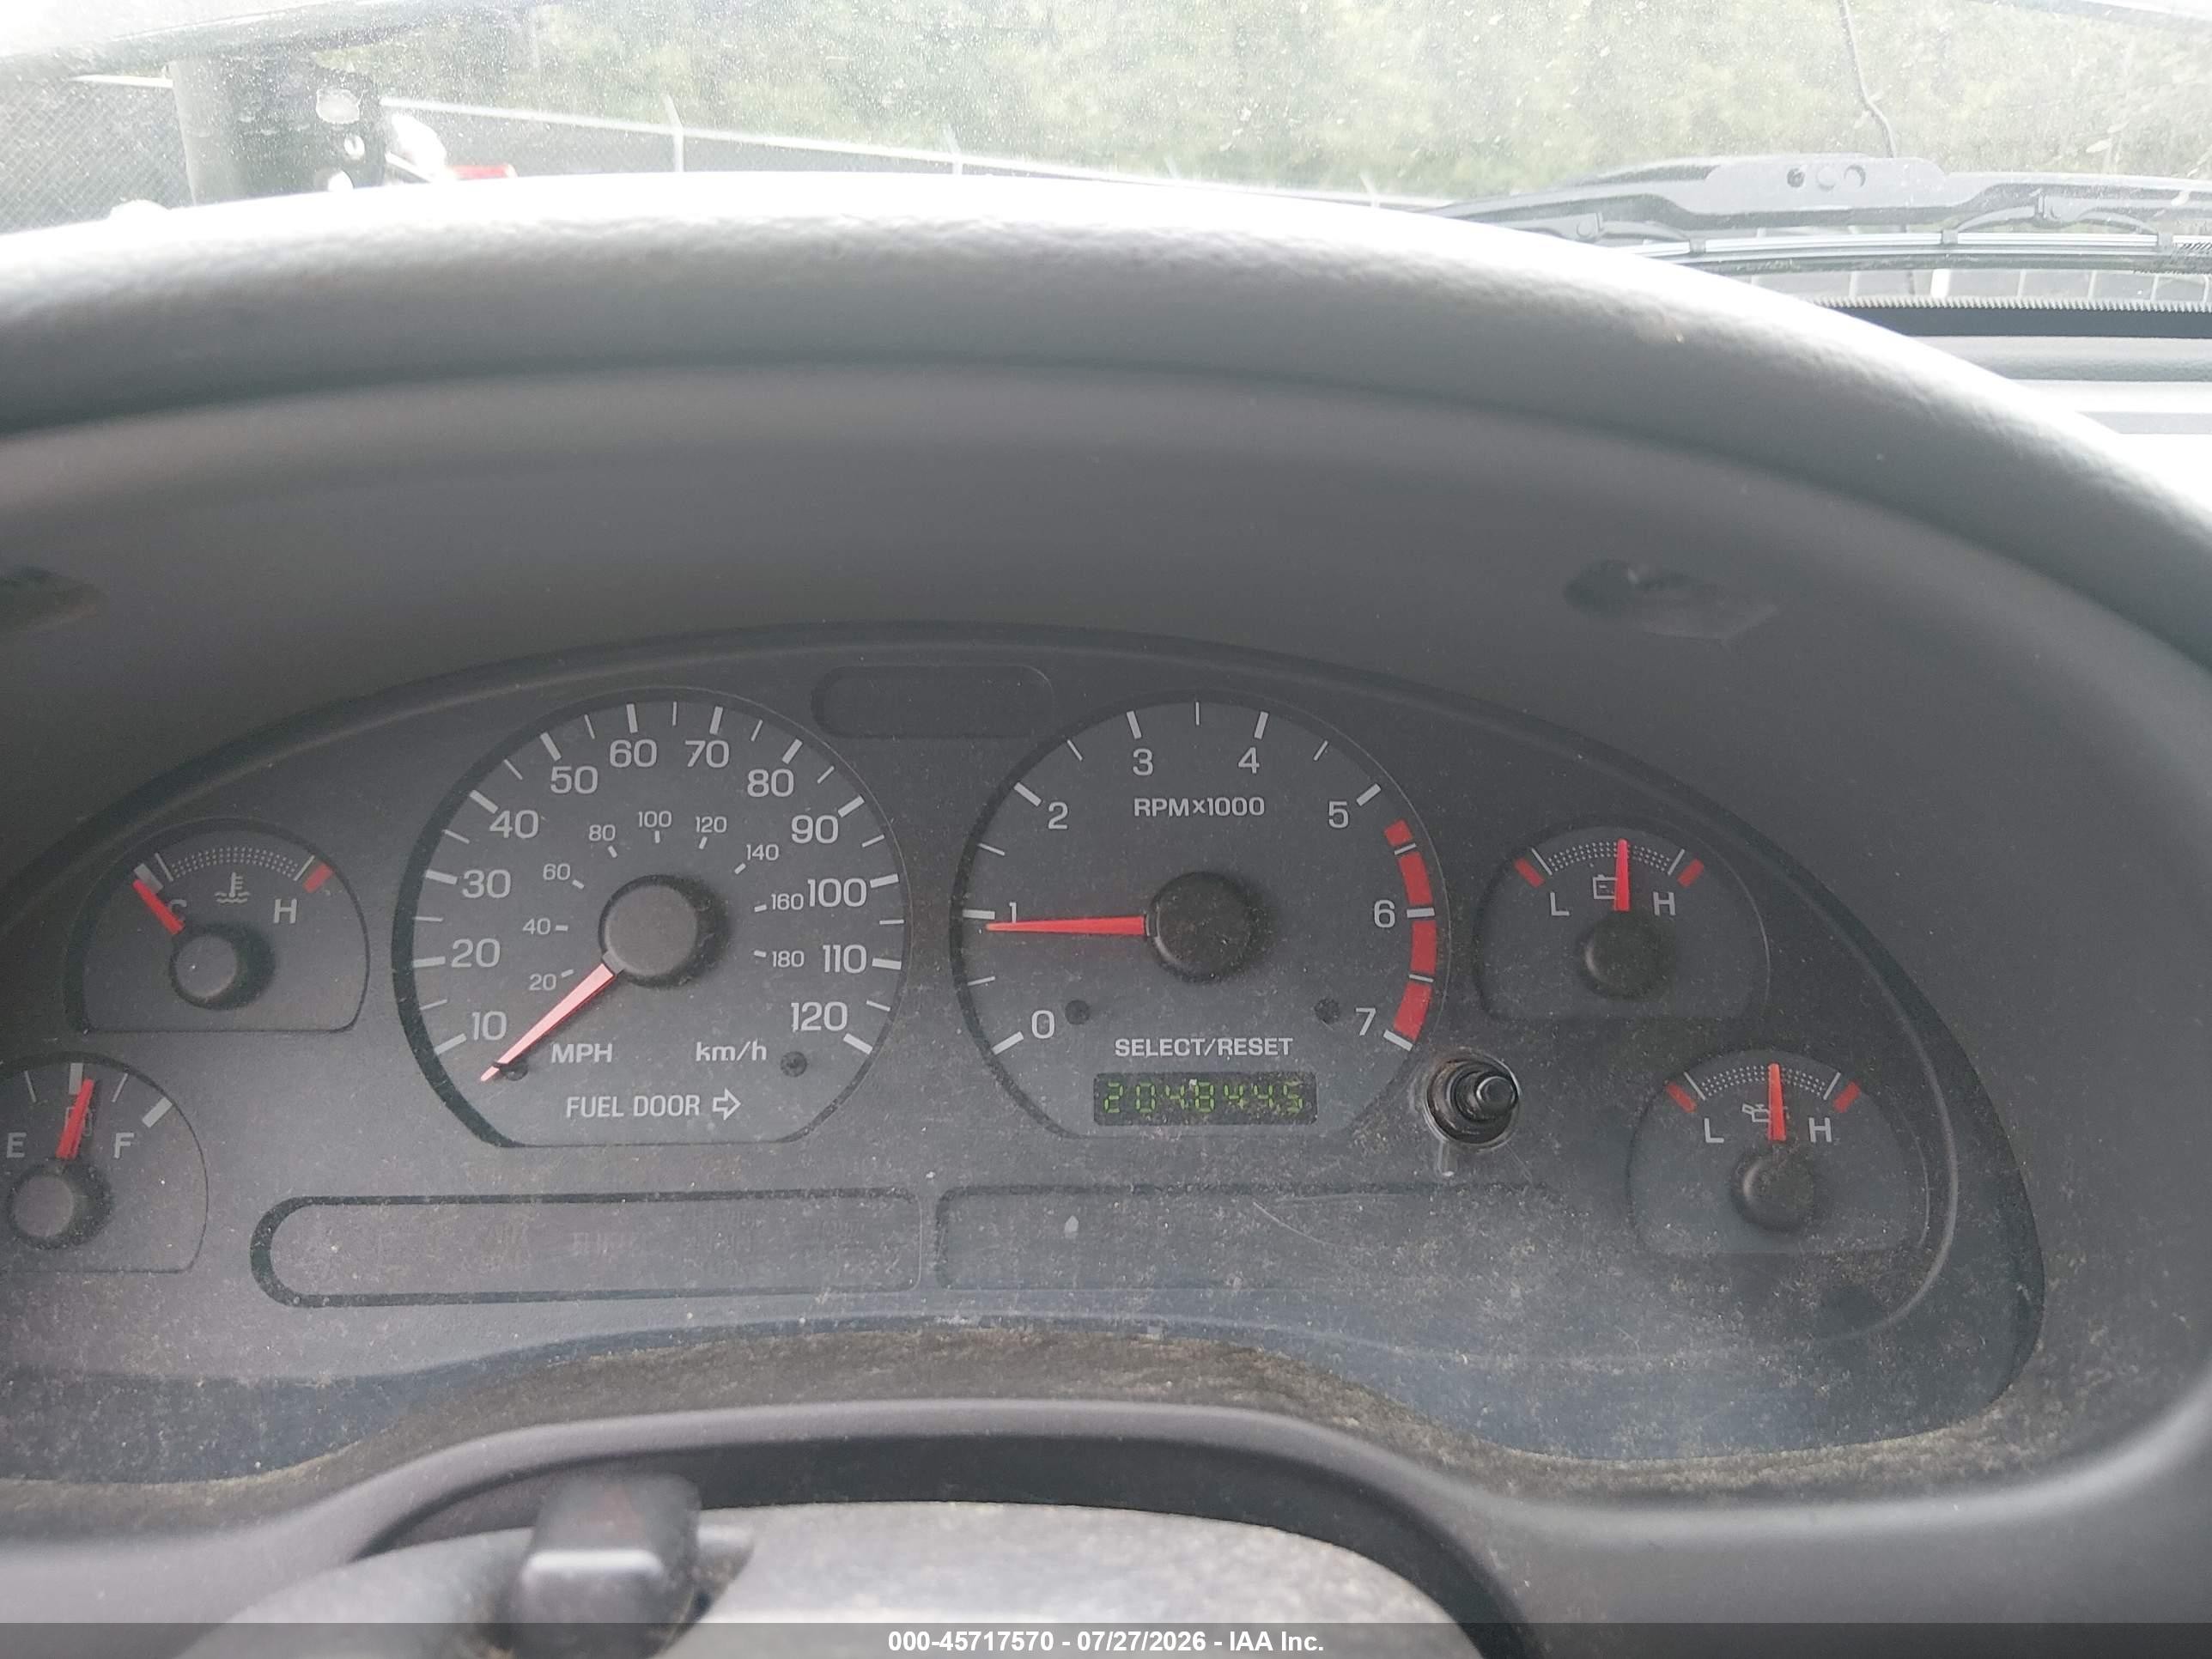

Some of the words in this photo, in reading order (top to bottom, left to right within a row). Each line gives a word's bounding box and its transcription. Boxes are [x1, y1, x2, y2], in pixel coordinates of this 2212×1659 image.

[609, 738, 659, 769] 60
[684, 738, 731, 769] 70
[1132, 748, 1154, 777] 3
[1237, 747, 1261, 775] 4
[550, 765, 599, 795] 50
[746, 768, 795, 799] 80
[489, 808, 540, 840] 40
[637, 809, 673, 829] 100
[695, 815, 728, 834] 120
[790, 813, 840, 845] 90
[1047, 801, 1070, 830] 2
[1327, 800, 1350, 830] 5
[587, 823, 617, 842] 80
[745, 842, 781, 862] 140
[461, 867, 512, 900] 30
[542, 862, 572, 882] 60
[770, 891, 805, 911] 160
[805, 877, 869, 908] 100
[1549, 891, 1571, 917] L
[1652, 891, 1677, 916] H
[272, 897, 299, 925] H
[1373, 898, 1396, 928] 6
[521, 916, 552, 936] 40
[450, 937, 501, 969] 20
[771, 950, 805, 969] 180
[821, 942, 867, 972] 110
[527, 972, 557, 992] 20
[471, 1010, 507, 1042] 10
[790, 1000, 848, 1031] 120
[1030, 1010, 1055, 1040] 0
[1354, 1006, 1376, 1036] 7
[550, 1042, 614, 1065] MPH
[695, 1039, 768, 1063] km/h
[1114, 1036, 1294, 1058] SELECT/RESET
[565, 1095, 625, 1119] FUEL
[632, 1093, 702, 1118] DOOR
[1704, 1117, 1725, 1144] L
[1808, 1117, 1832, 1144] H
[5, 1132, 27, 1159] E
[112, 1131, 135, 1159] F
